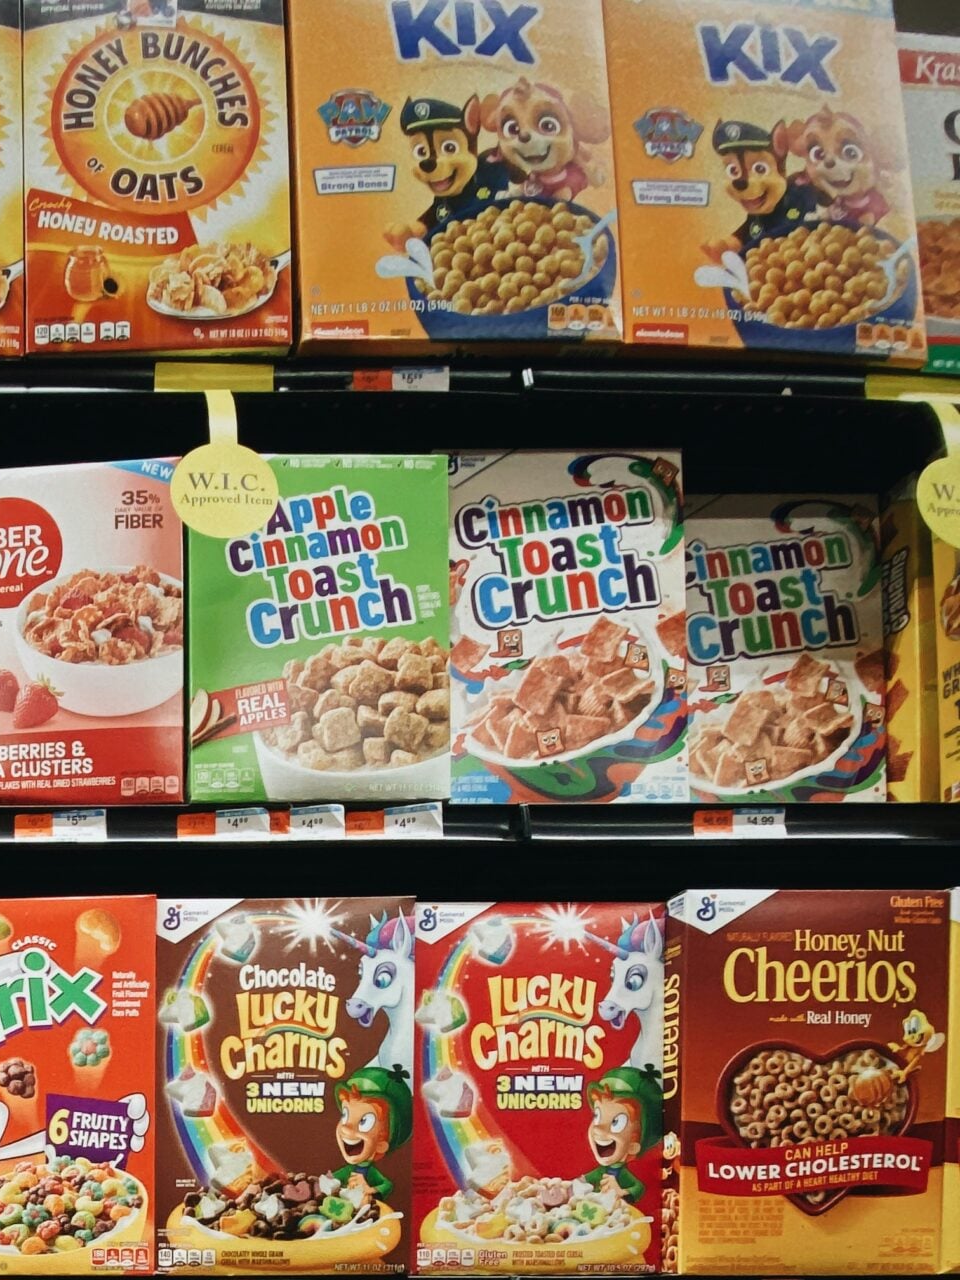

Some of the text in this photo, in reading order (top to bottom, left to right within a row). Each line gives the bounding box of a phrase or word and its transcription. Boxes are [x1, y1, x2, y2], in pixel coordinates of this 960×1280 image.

[392, 0, 537, 63] KIX
[699, 22, 837, 92] KIX
[189, 473, 266, 492] W.I.C.
[122, 490, 160, 505] 35%
[179, 493, 273, 507] Approved Item
[267, 554, 380, 602] Toast
[249, 581, 411, 644] Crunch
[237, 694, 284, 715] REAL
[239, 705, 286, 724] APPLES
[72, 741, 84, 757] &
[11, 758, 92, 776] CLUSTERS
[794, 929, 904, 957] Honey Nut
[240, 962, 336, 991] Chocolate
[723, 946, 917, 1004] Cheerios
[220, 1032, 348, 1080] Charms
[246, 1098, 324, 1113] UNICORNS
[49, 1109, 130, 1145] 6 FRUITY
[70, 1131, 128, 1150] SHAPES
[785, 1142, 848, 1160] CAN HELP
[708, 1154, 920, 1180] LOWER CHOLESTEROL
